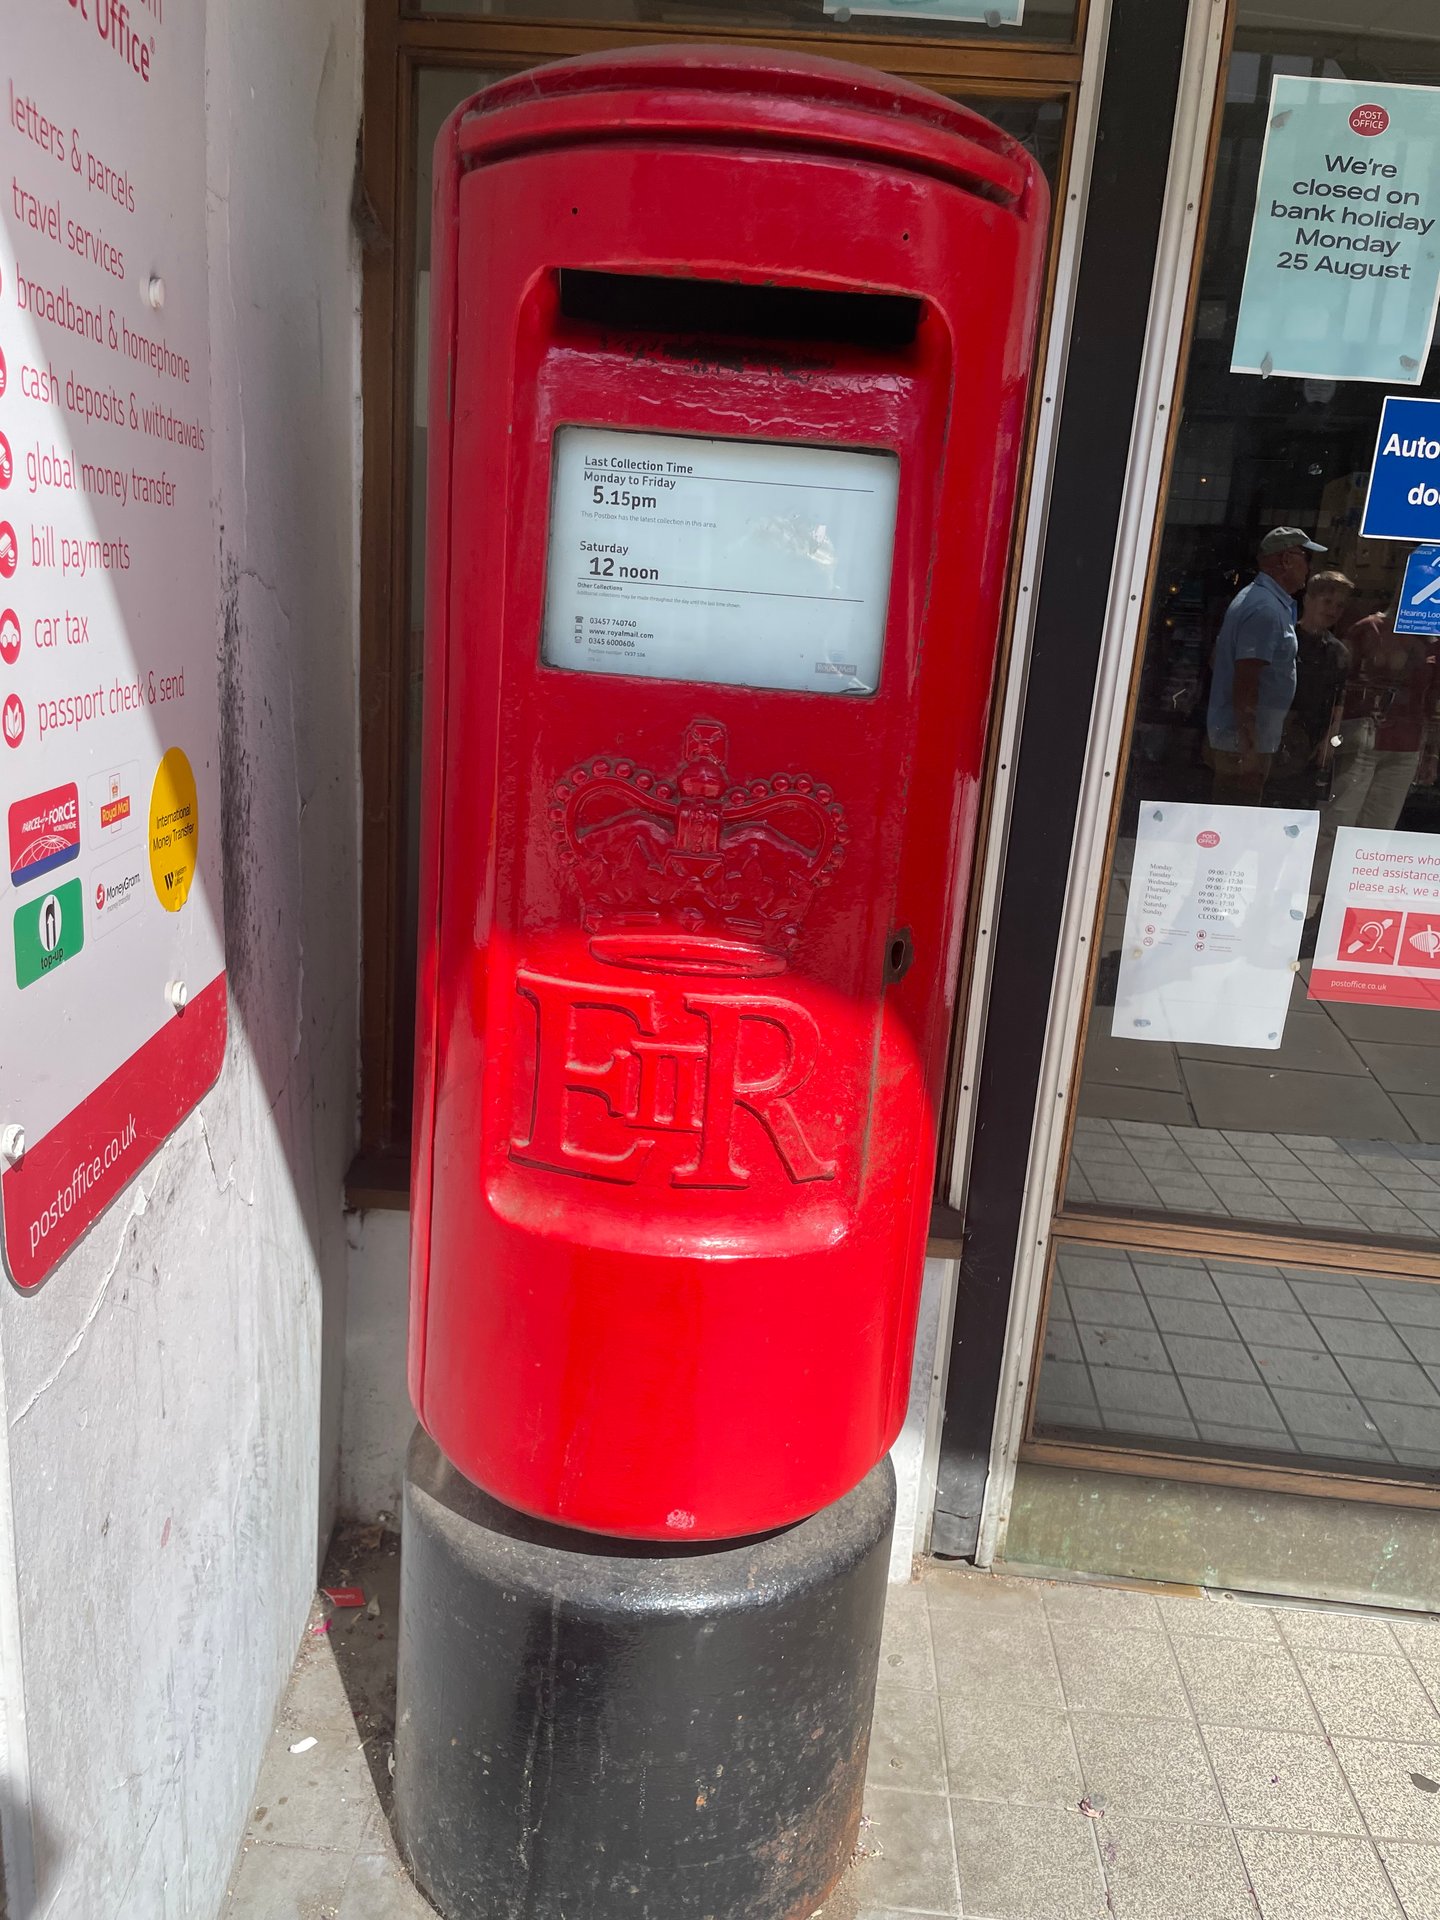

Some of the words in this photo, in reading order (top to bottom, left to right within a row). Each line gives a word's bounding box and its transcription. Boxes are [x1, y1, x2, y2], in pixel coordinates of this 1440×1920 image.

[1352, 119, 1384, 130] OFFICE
[1359, 110, 1383, 120] POST
[9, 78, 65, 162] letters
[71, 128, 83, 176] &
[87, 150, 136, 213] parcels
[1325, 155, 1398, 178] We're
[1292, 179, 1380, 202] closed
[1386, 190, 1420, 206] on
[12, 176, 62, 244] travel
[67, 218, 125, 280] services
[1270, 200, 1336, 223] bank
[1342, 207, 1435, 236] holiday
[1295, 228, 1401, 258] Monday
[1276, 252, 1309, 271] 25
[1314, 256, 1411, 280] August
[16, 263, 103, 345] broadband
[108, 309, 119, 351] &
[122, 317, 190, 383] homephone
[21, 362, 60, 407] cash
[66, 370, 125, 426] deposits
[129, 392, 139, 431] &
[142, 402, 205, 451] withdrawals
[26, 441, 77, 494] global
[81, 463, 128, 507] money
[132, 468, 177, 506] transfer
[584, 455, 608, 467] Last
[610, 457, 663, 472] Collection
[666, 462, 693, 474] Time
[583, 471, 626, 486] Monday
[629, 475, 640, 485] to
[642, 476, 676, 490] Friday
[592, 485, 657, 510] 5.15pm
[1407, 483, 1440, 506] do
[593, 512, 617, 520] Postbox
[657, 517, 684, 526] collection
[31, 524, 56, 567] bill
[60, 536, 131, 577] payments
[579, 540, 629, 556] Saturday
[589, 557, 615, 577] 12
[619, 566, 659, 580] noon
[589, 617, 610, 625] 03457
[612, 619, 637, 627] 740740
[1400, 609, 1427, 619] Hearing
[34, 617, 60, 648] car
[65, 609, 90, 645] tax
[589, 629, 654, 639] www.royalmail.com
[588, 637, 605, 645] 0345
[606, 639, 636, 647] 6000606
[38, 684, 104, 741] passport
[108, 675, 145, 714] check
[147, 670, 157, 705] &
[160, 666, 186, 702] send
[102, 805, 117, 823] Royal
[117, 799, 129, 815] Mail
[156, 803, 191, 829] International
[152, 833, 172, 851] Money
[172, 822, 194, 841] Transfer
[1150, 863, 1172, 871] Monday
[1355, 849, 1414, 864] Customers
[1149, 871, 1171, 879] Tuesday
[1352, 865, 1379, 877] need
[1147, 886, 1171, 894] Thursday
[1148, 878, 1178, 887] Wednesday
[1349, 881, 1384, 893] please
[1413, 887, 1429, 897] we
[1144, 901, 1167, 909] Saturday
[1145, 893, 1162, 901] Friday
[1142, 908, 1162, 916] Sunday
[40, 947, 64, 970] top-up
[1331, 979, 1387, 991] postoffice.co.uk
[29, 1113, 137, 1258] postoffice.co.uk
